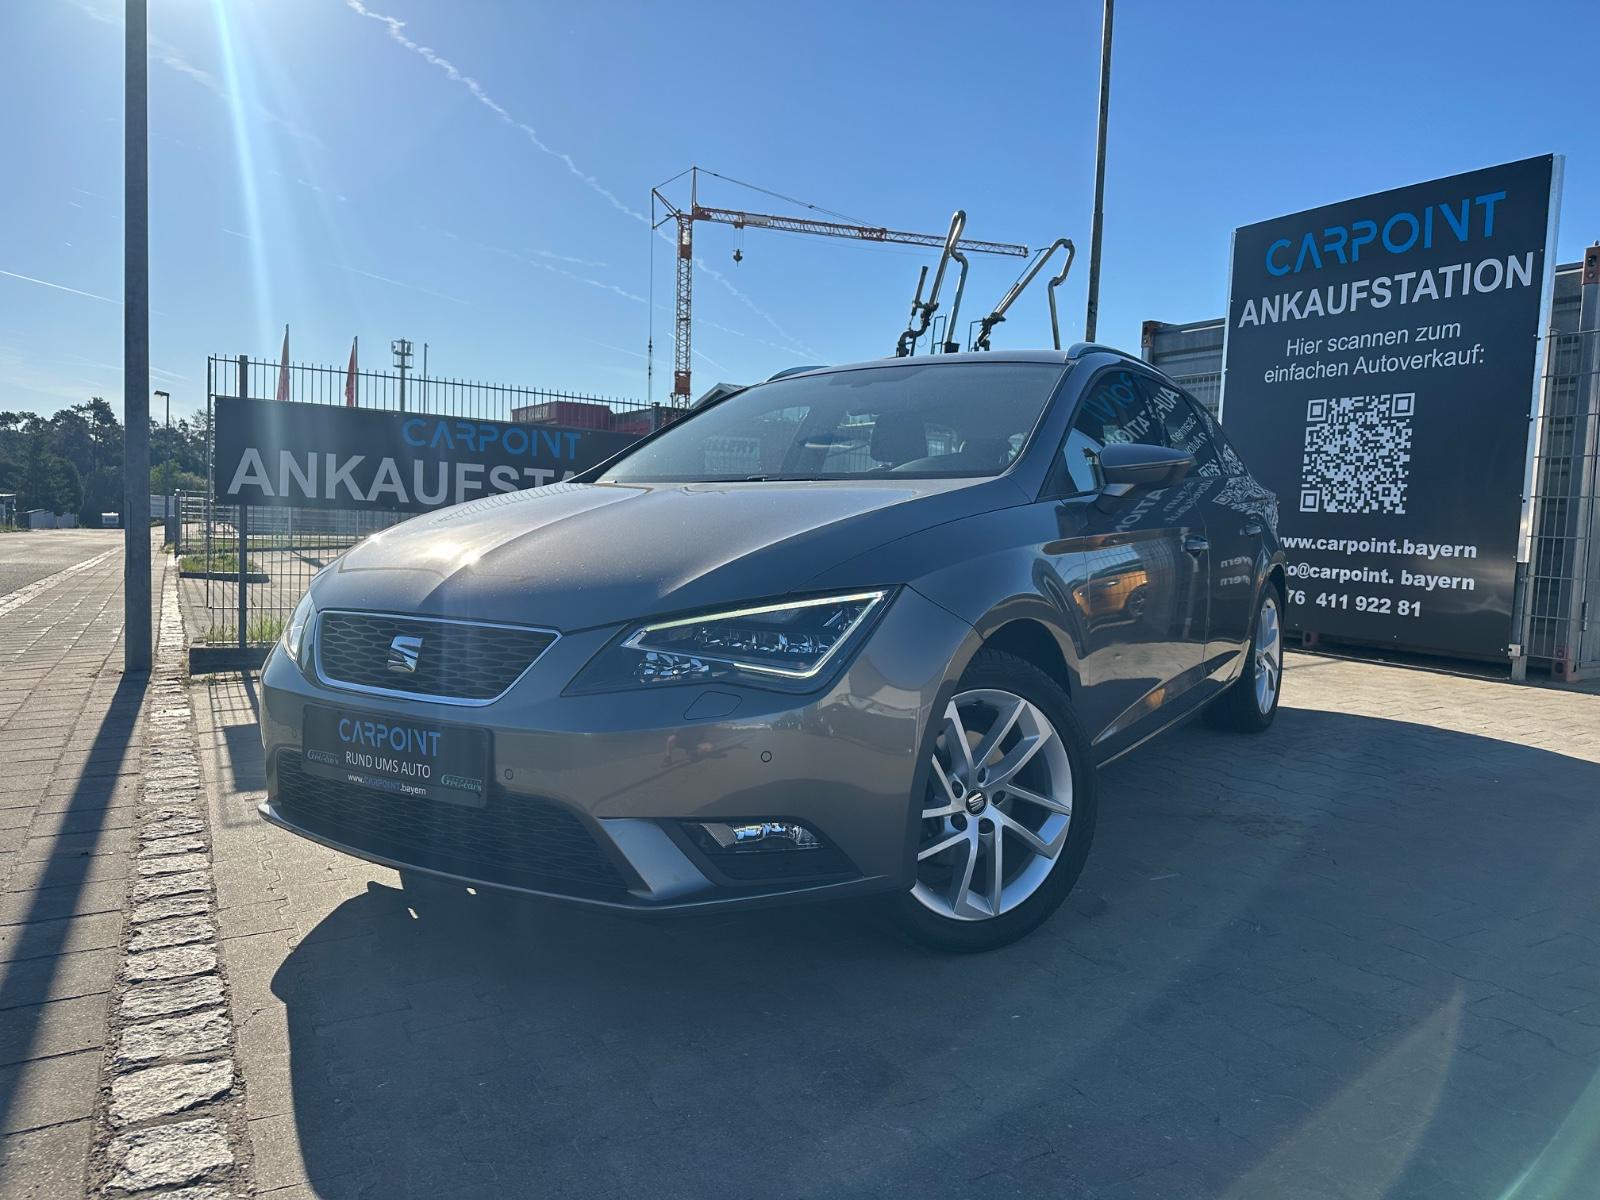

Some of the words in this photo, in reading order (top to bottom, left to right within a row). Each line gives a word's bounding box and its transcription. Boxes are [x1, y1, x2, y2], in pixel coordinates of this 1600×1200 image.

[1265, 191, 1506, 277] CARPOINT
[1238, 252, 1534, 328] ANKAUFSTATION
[1286, 338, 1321, 357] Hier
[1327, 329, 1409, 352] scannen
[1415, 322, 1461, 342] zum
[1264, 356, 1349, 383] einfachen
[1353, 344, 1485, 375] Autoverkauf:
[403, 418, 581, 460] CARPOINT
[227, 447, 577, 506] ANKAUFST
[1287, 562, 1394, 585] o@carpoint.
[1401, 569, 1475, 592] bayern
[1316, 593, 1348, 611] 411
[1355, 596, 1391, 615] 922
[1397, 600, 1421, 618] 81
[338, 718, 441, 757] CARPOINT
[346, 751, 373, 768] RUND
[375, 758, 399, 773] UMS
[401, 762, 431, 778] AUTO
